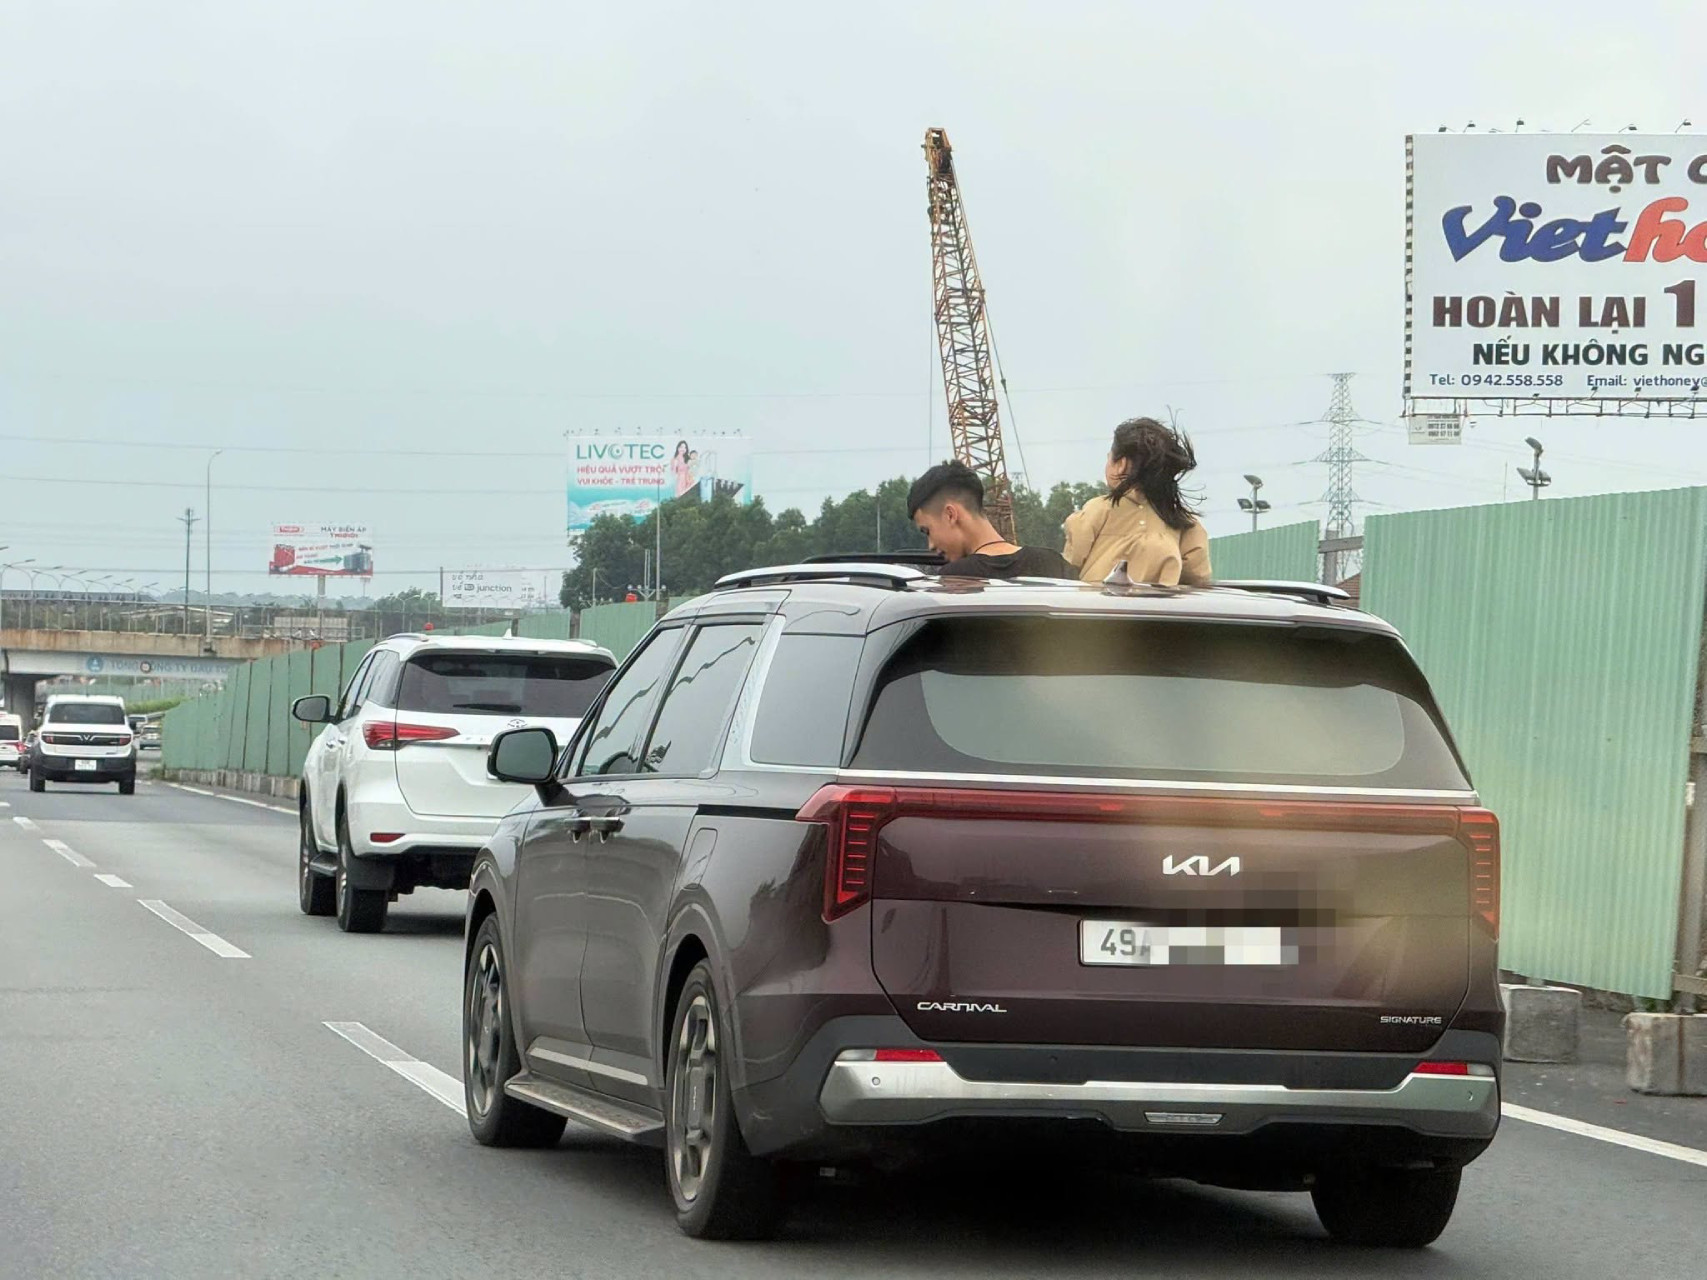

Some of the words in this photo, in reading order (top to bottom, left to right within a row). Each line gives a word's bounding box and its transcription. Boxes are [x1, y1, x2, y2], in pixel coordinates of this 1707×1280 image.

[1546, 145, 1672, 193] MẬT
[1432, 291, 1560, 328] HOÀN
[1578, 296, 1646, 334] LẠI
[1472, 336, 1530, 366] NẾU
[1541, 340, 1649, 366] KHÔNG
[1429, 374, 1455, 386] Tel:
[1587, 374, 1626, 387] Email:
[576, 443, 665, 460] LIVOTEC
[476, 584, 512, 593] junction
[1162, 855, 1240, 877] KIA
[916, 1001, 1008, 1014] CARNIVAL
[1380, 1015, 1442, 1025] SIGNATURE
